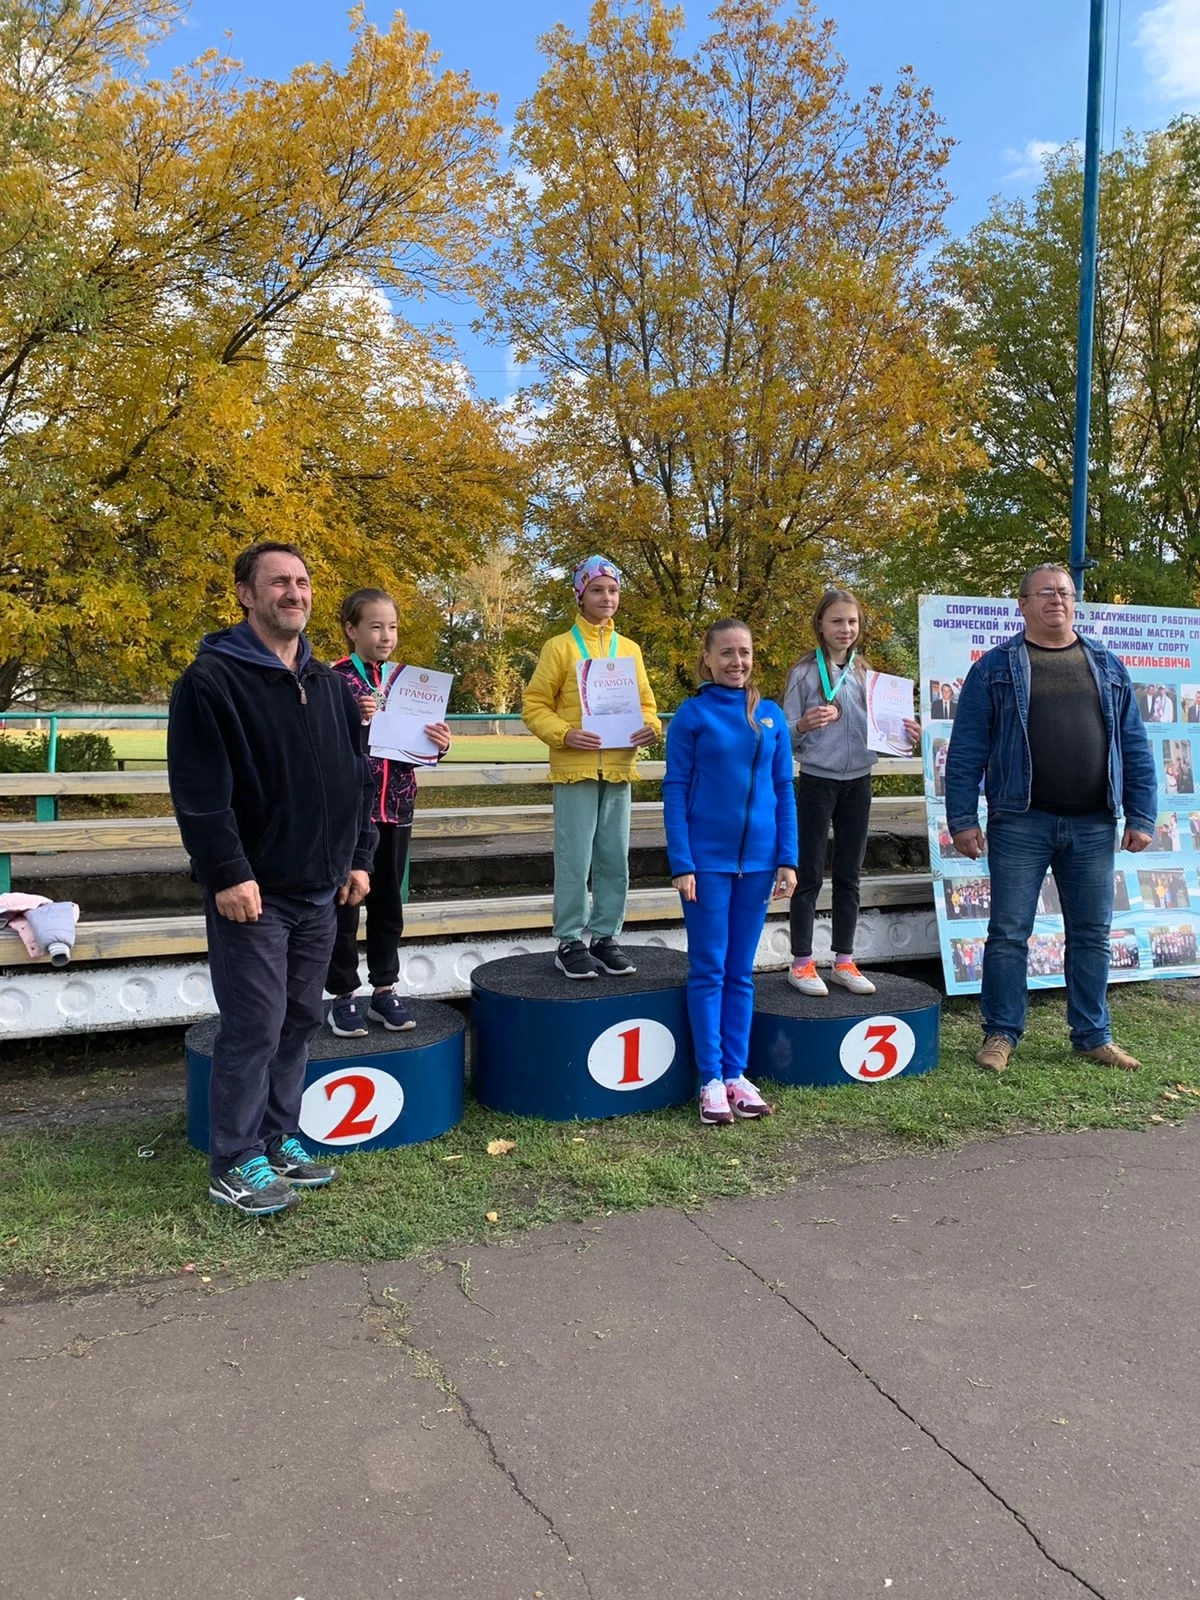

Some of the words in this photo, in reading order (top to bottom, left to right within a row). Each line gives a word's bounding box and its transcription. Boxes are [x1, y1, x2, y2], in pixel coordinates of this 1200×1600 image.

[946, 604, 1009, 617] СПОРТИВНАЯ
[1089, 610, 1158, 624] ЗАСЛУЖЕННОГО
[1161, 615, 1200, 626] РАБОТНИ
[933, 617, 999, 631] ФИЗИЧЕСКОЙ
[1102, 625, 1143, 637] ДВАЖДЫ
[1147, 628, 1186, 639] МАСТЕРА
[971, 634, 985, 645] ПО
[1107, 639, 1154, 651] ЛЫЖНОМУ
[1158, 642, 1190, 653] СПОРТУ
[400, 687, 444, 703] ГРАМОТА
[617, 1026, 644, 1085] 1
[858, 1024, 898, 1078] 3
[322, 1074, 378, 1140] 2
